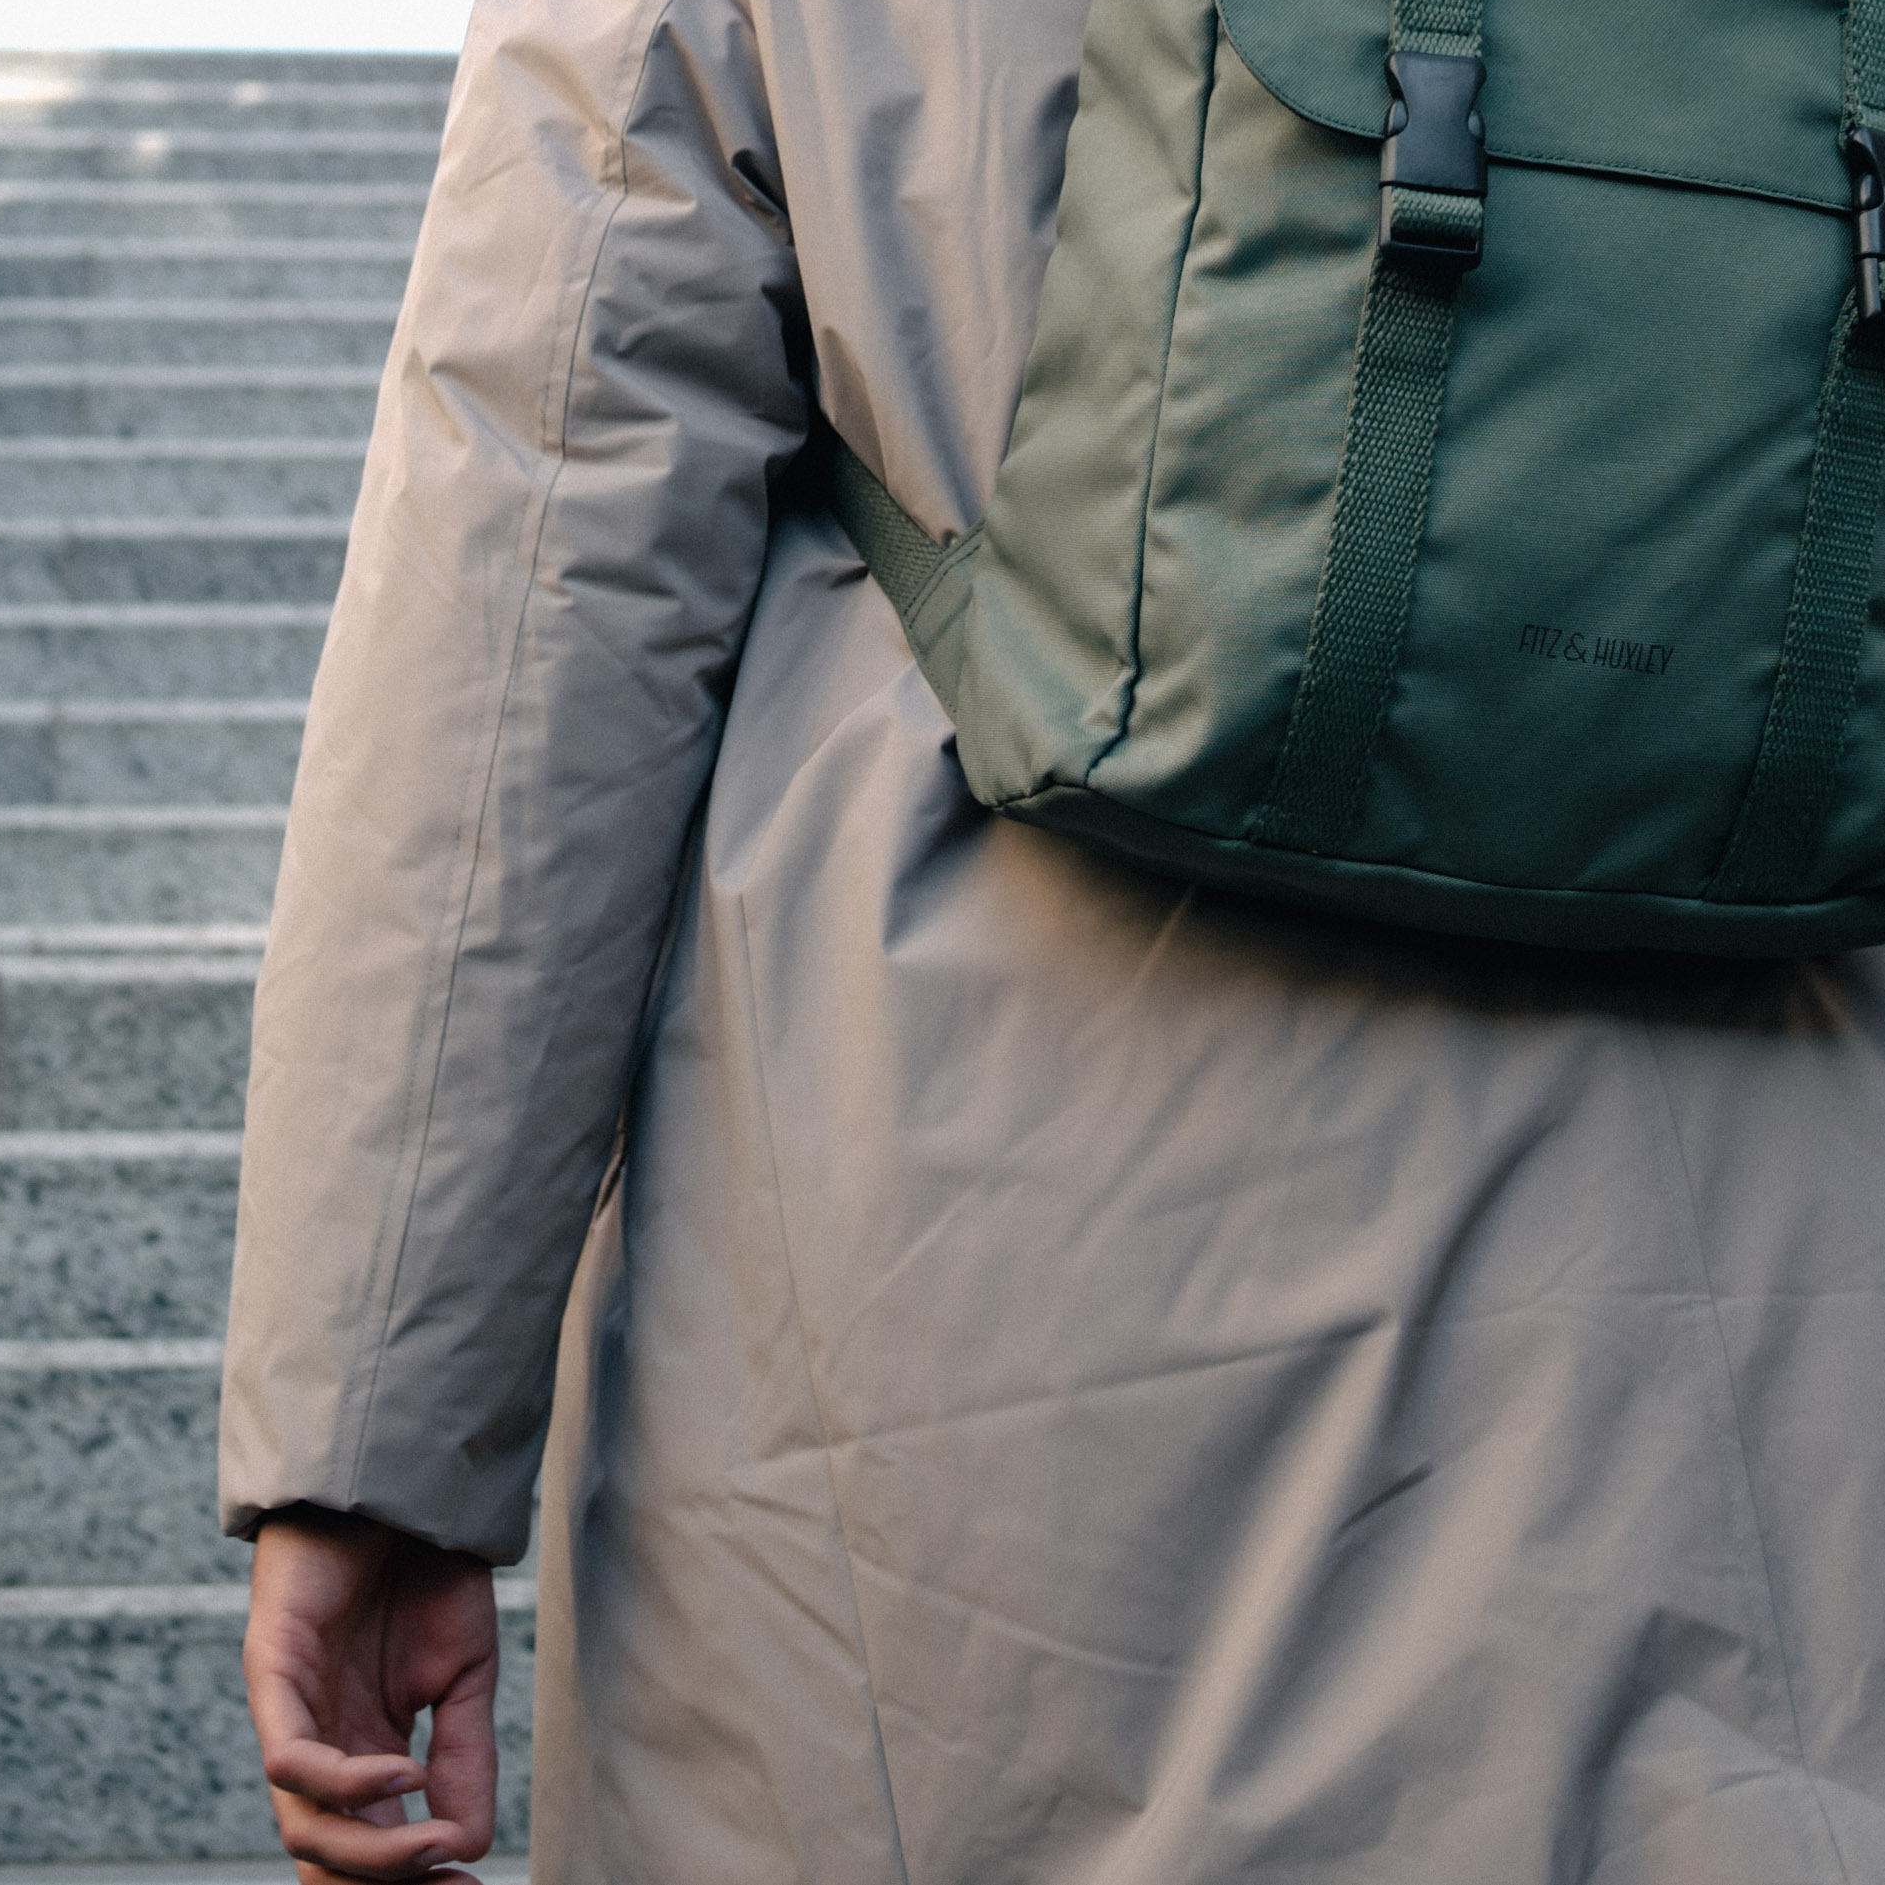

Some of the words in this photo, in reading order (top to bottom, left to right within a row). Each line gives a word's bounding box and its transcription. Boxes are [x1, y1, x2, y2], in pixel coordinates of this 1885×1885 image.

[1518, 623, 1563, 659] FITZ
[1563, 632, 1587, 664] &
[1592, 636, 1674, 675] HUXLEY
